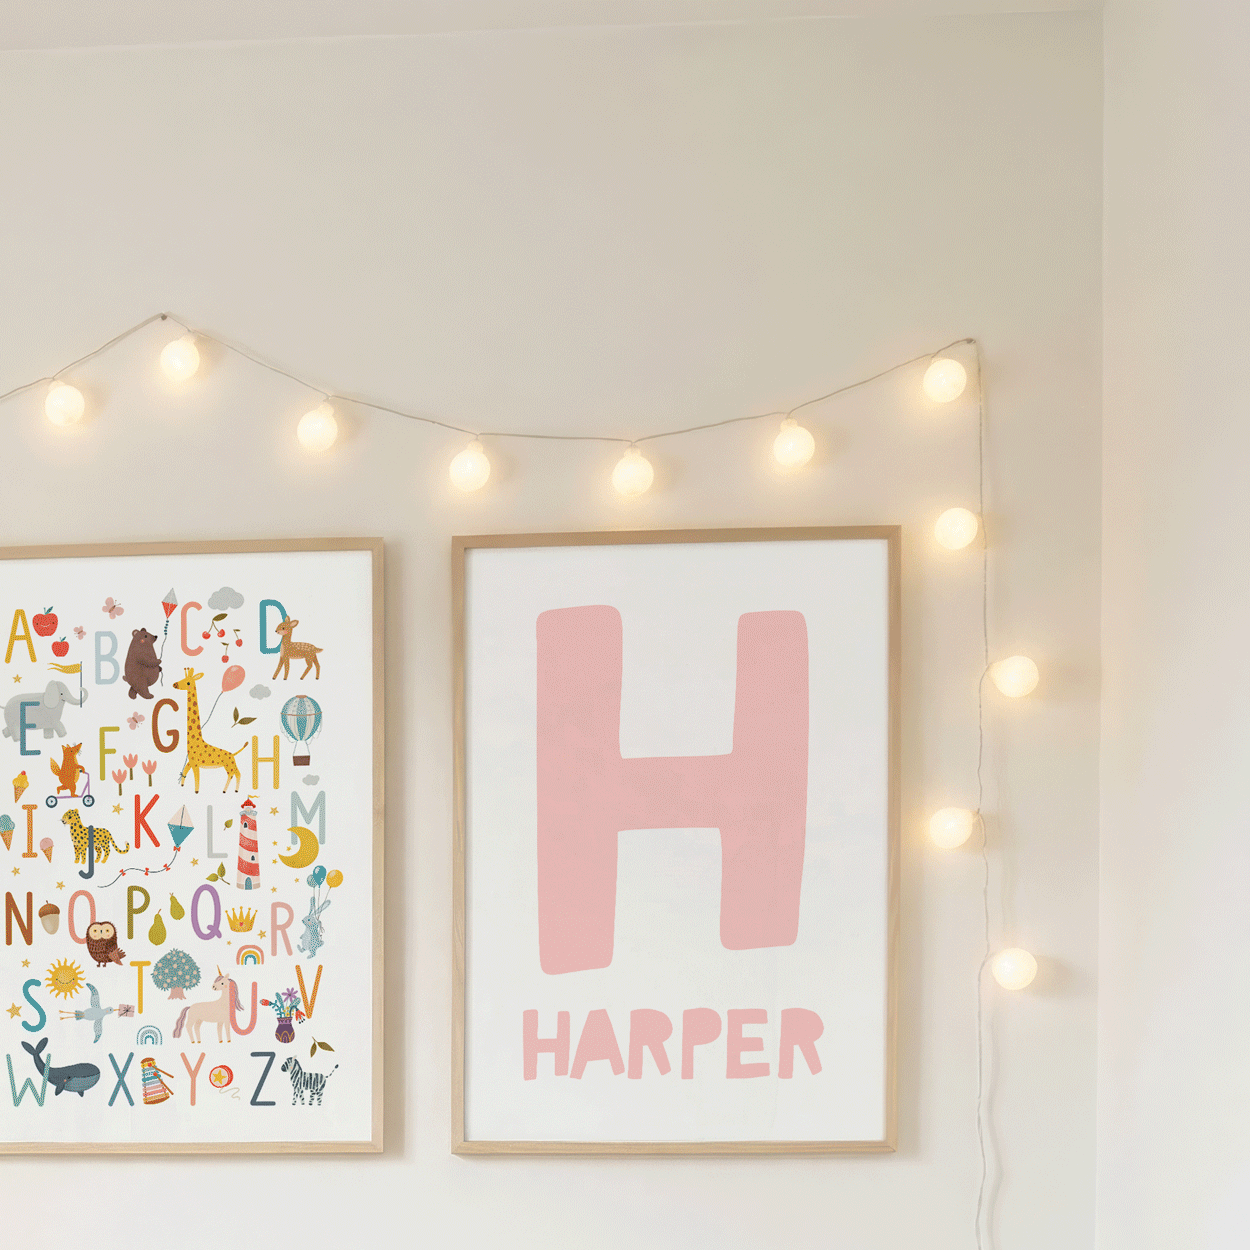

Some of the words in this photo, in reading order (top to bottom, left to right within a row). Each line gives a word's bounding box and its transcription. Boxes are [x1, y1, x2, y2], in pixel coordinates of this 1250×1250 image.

[5, 609, 37, 663] A
[94, 630, 120, 685] B
[180, 601, 204, 656] C
[259, 599, 287, 654] D
[19, 701, 41, 756] E
[99, 726, 120, 781] F
[152, 698, 180, 753] G
[252, 735, 280, 790] H
[536, 605, 809, 975] H
[21, 804, 38, 858] I
[78, 825, 94, 879] J
[134, 794, 161, 849] K
[207, 804, 229, 858] L
[290, 790, 326, 845] M
[5, 891, 33, 946] N
[67, 889, 97, 944] O
[127, 885, 150, 940] P
[190, 883, 222, 941] Q
[270, 901, 294, 957] R
[21, 978, 46, 1032] S
[129, 960, 151, 1014] T
[229, 981, 258, 1036] U
[295, 964, 323, 1019] V
[5, 1053, 51, 1107] W
[107, 1052, 135, 1106] X
[180, 1052, 206, 1106] Y
[250, 1051, 276, 1106] Z
[522, 1007, 824, 1080] HARPER
